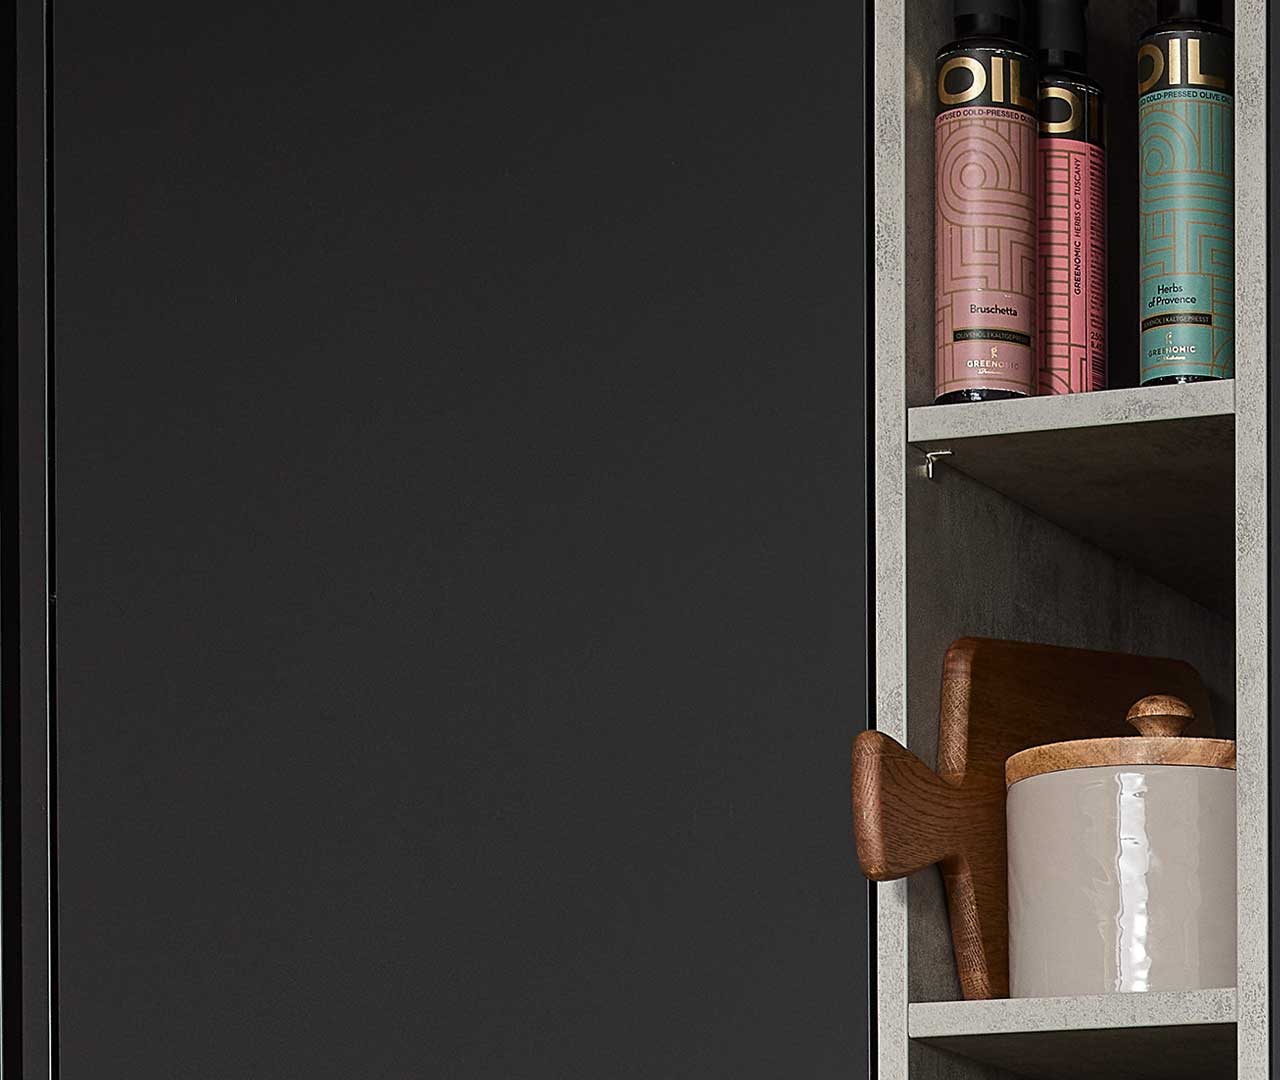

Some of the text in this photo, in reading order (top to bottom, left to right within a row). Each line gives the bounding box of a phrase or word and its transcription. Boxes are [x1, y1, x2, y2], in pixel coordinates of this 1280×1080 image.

[1138, 38, 1226, 95] OIL
[939, 56, 1035, 107] OIL
[1146, 91, 1198, 104] COLD-PRESSED
[1199, 91, 1221, 101] OLIVE
[963, 109, 1019, 120] COLD-PRESSED
[1074, 198, 1081, 210] OF
[1157, 283, 1183, 295] Herbs
[1156, 296, 1197, 307] Provence
[970, 304, 1018, 317] Bruschetta
